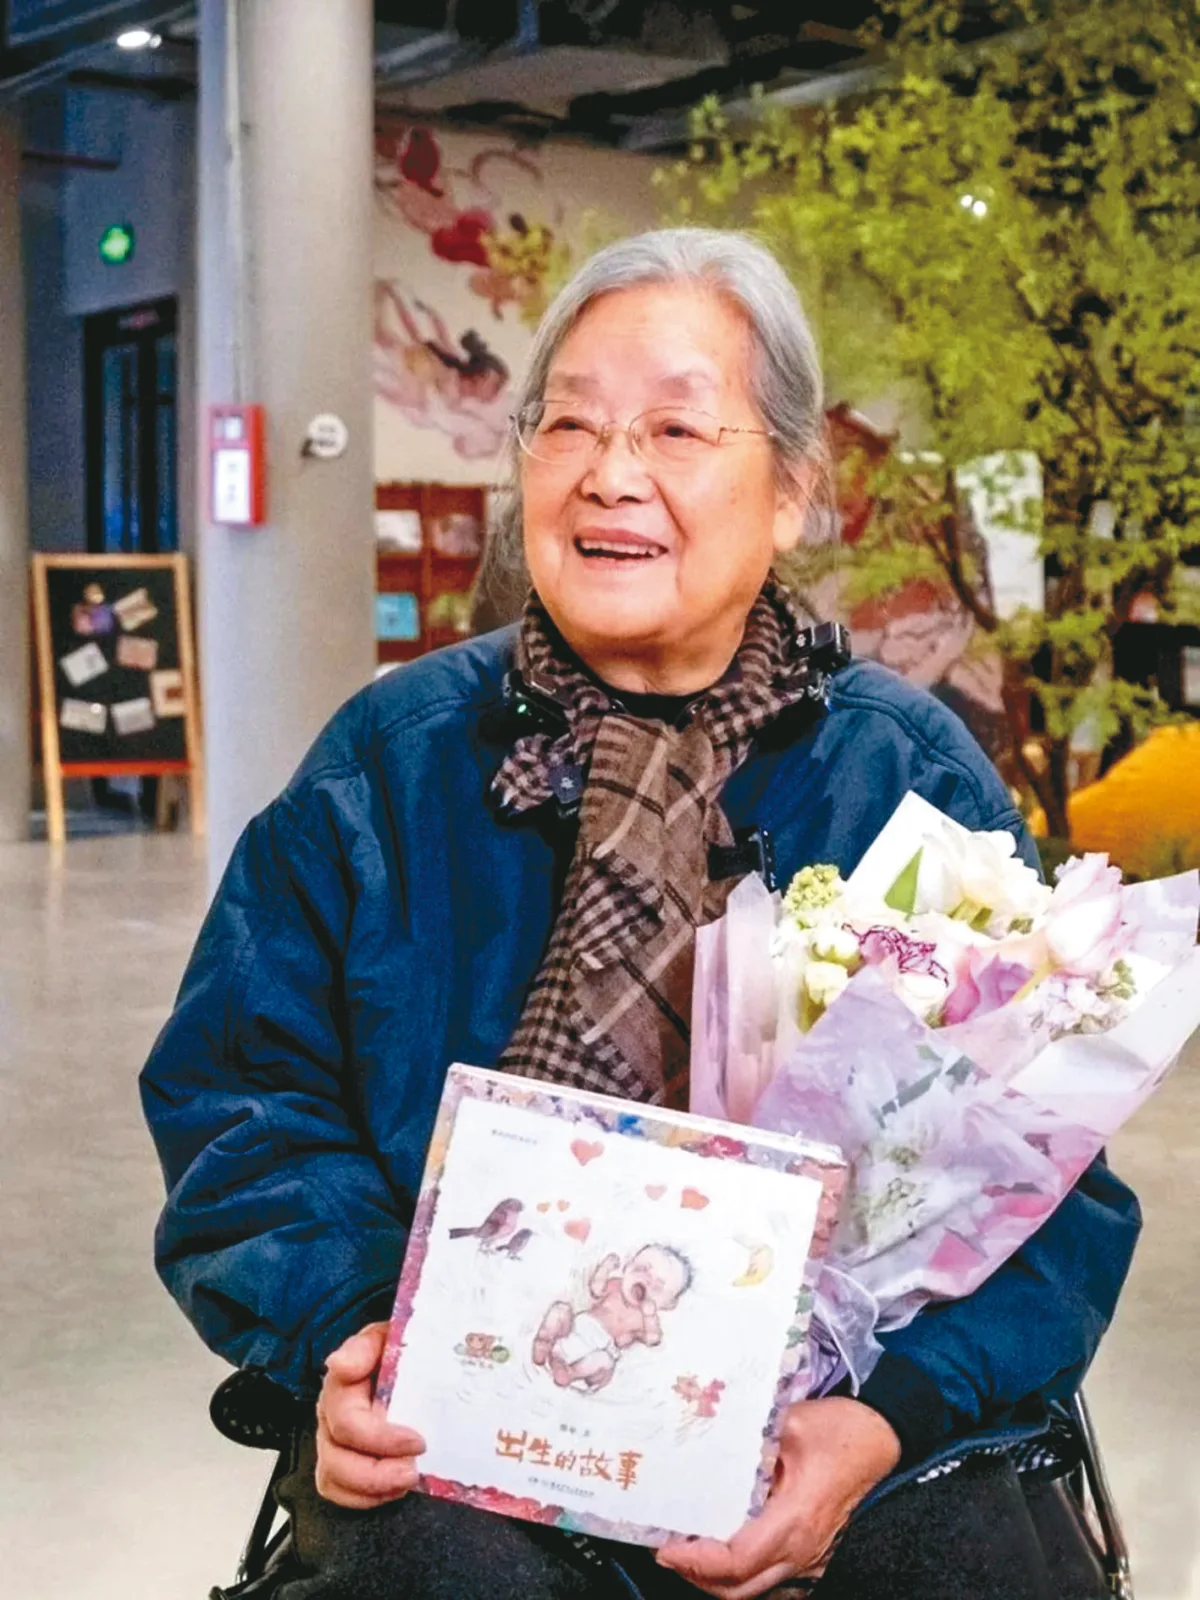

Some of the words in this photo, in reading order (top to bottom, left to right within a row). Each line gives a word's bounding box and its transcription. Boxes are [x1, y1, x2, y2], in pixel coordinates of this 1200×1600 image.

[495, 1428, 643, 1490] 出生的故事
